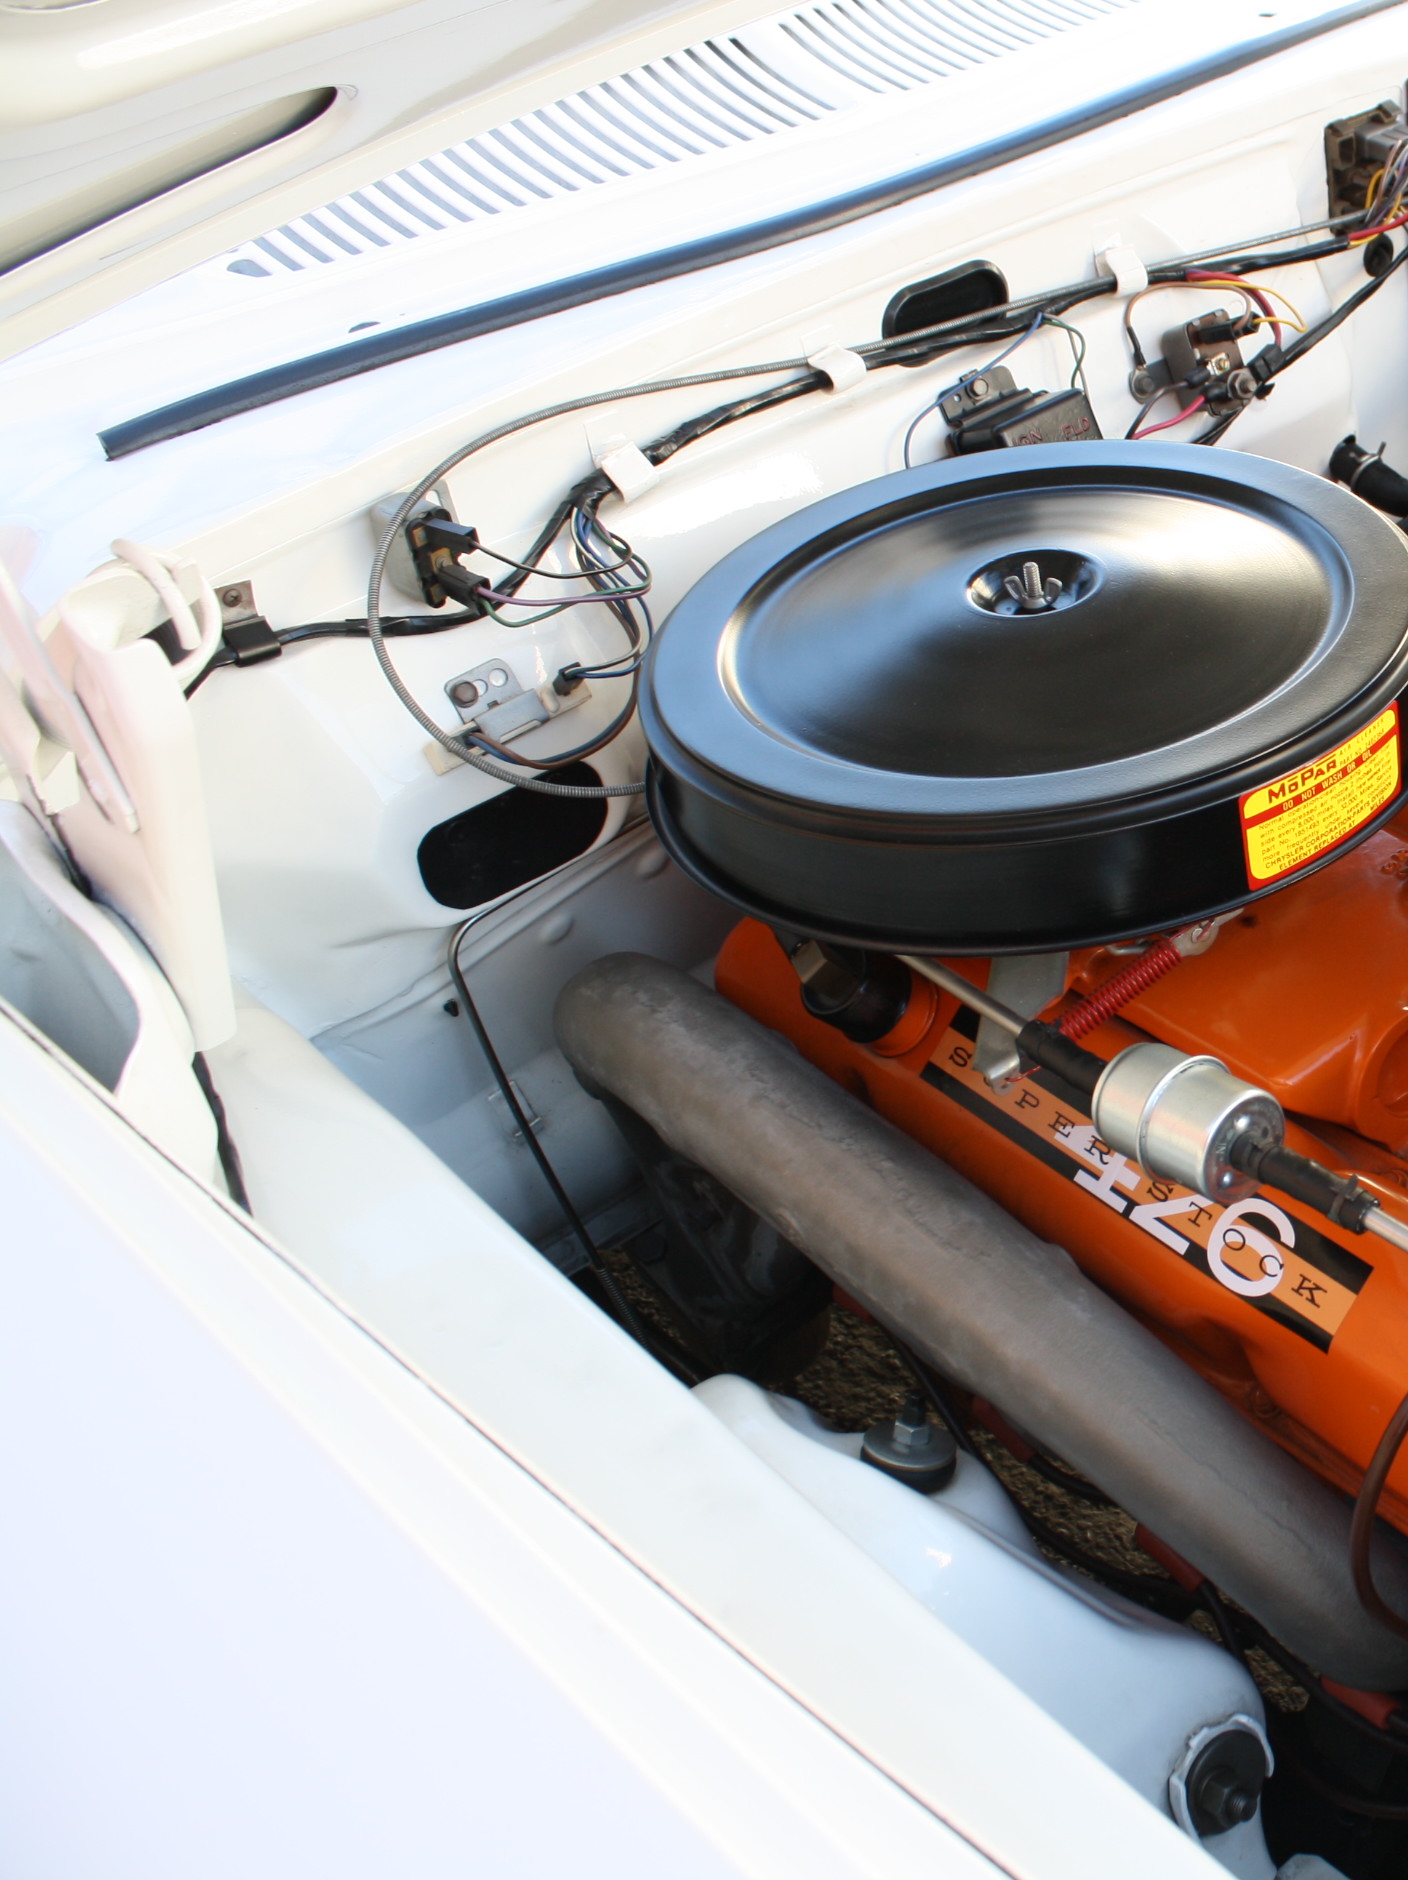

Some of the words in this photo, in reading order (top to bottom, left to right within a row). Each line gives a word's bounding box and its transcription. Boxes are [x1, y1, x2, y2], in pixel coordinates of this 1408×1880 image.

[1282, 798, 1294, 811] DO
[1301, 788, 1316, 802] NOT
[1321, 771, 1342, 790] WASH
[1346, 759, 1356, 774] OR
[1361, 746, 1372, 762] OIL
[1258, 814, 1284, 831] Normal
[1259, 825, 1274, 838] with
[1260, 834, 1275, 847] side
[1277, 825, 1295, 840] every
[1278, 847, 1312, 871] ELEMENT
[1313, 825, 1346, 852] REPLACED
[1347, 818, 1355, 830] AT
[1261, 842, 1276, 856] part
[1262, 849, 1280, 863] more
[1264, 844, 1304, 869] CHRYSLER
[949, 1045, 1115, 1167] SPER
[1147, 1178, 1328, 1309] STOCK
